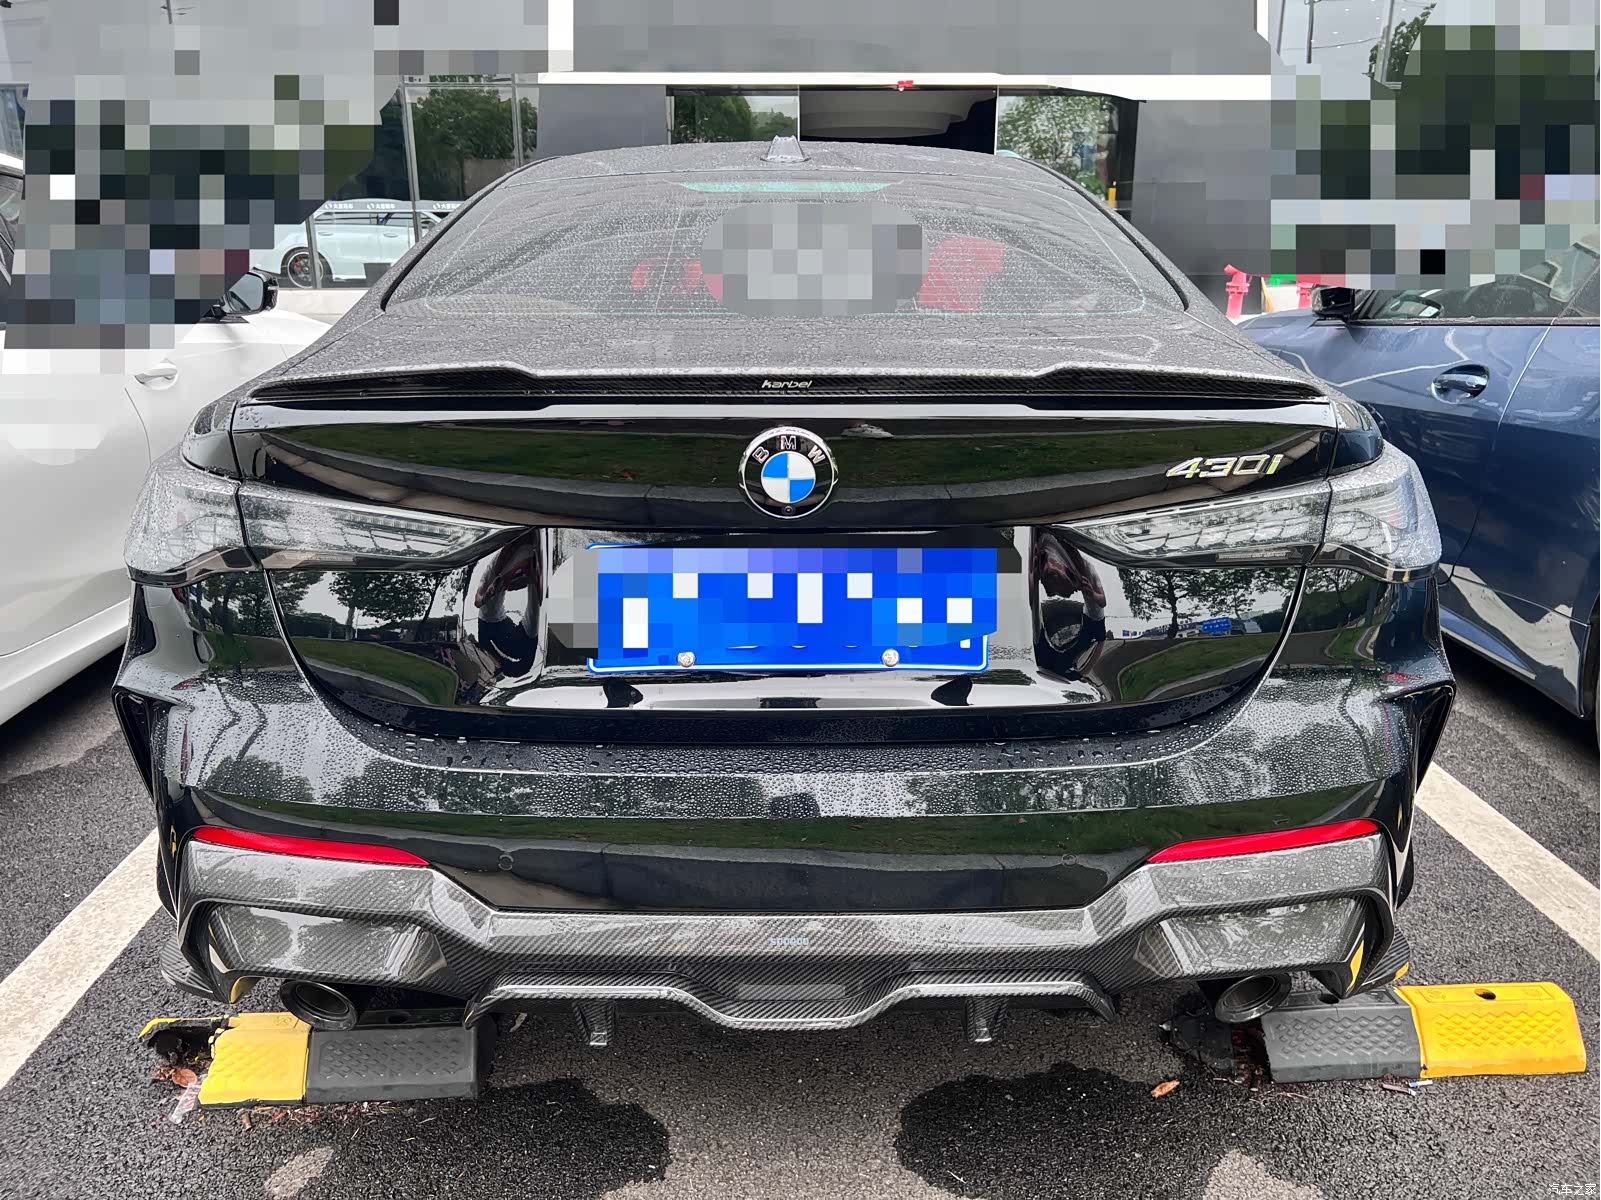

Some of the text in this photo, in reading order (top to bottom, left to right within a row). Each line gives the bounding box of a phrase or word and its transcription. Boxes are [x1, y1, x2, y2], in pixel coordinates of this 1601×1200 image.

[761, 379, 813, 389] karbel
[751, 435, 826, 464] BMW
[1165, 453, 1284, 479] 430i
